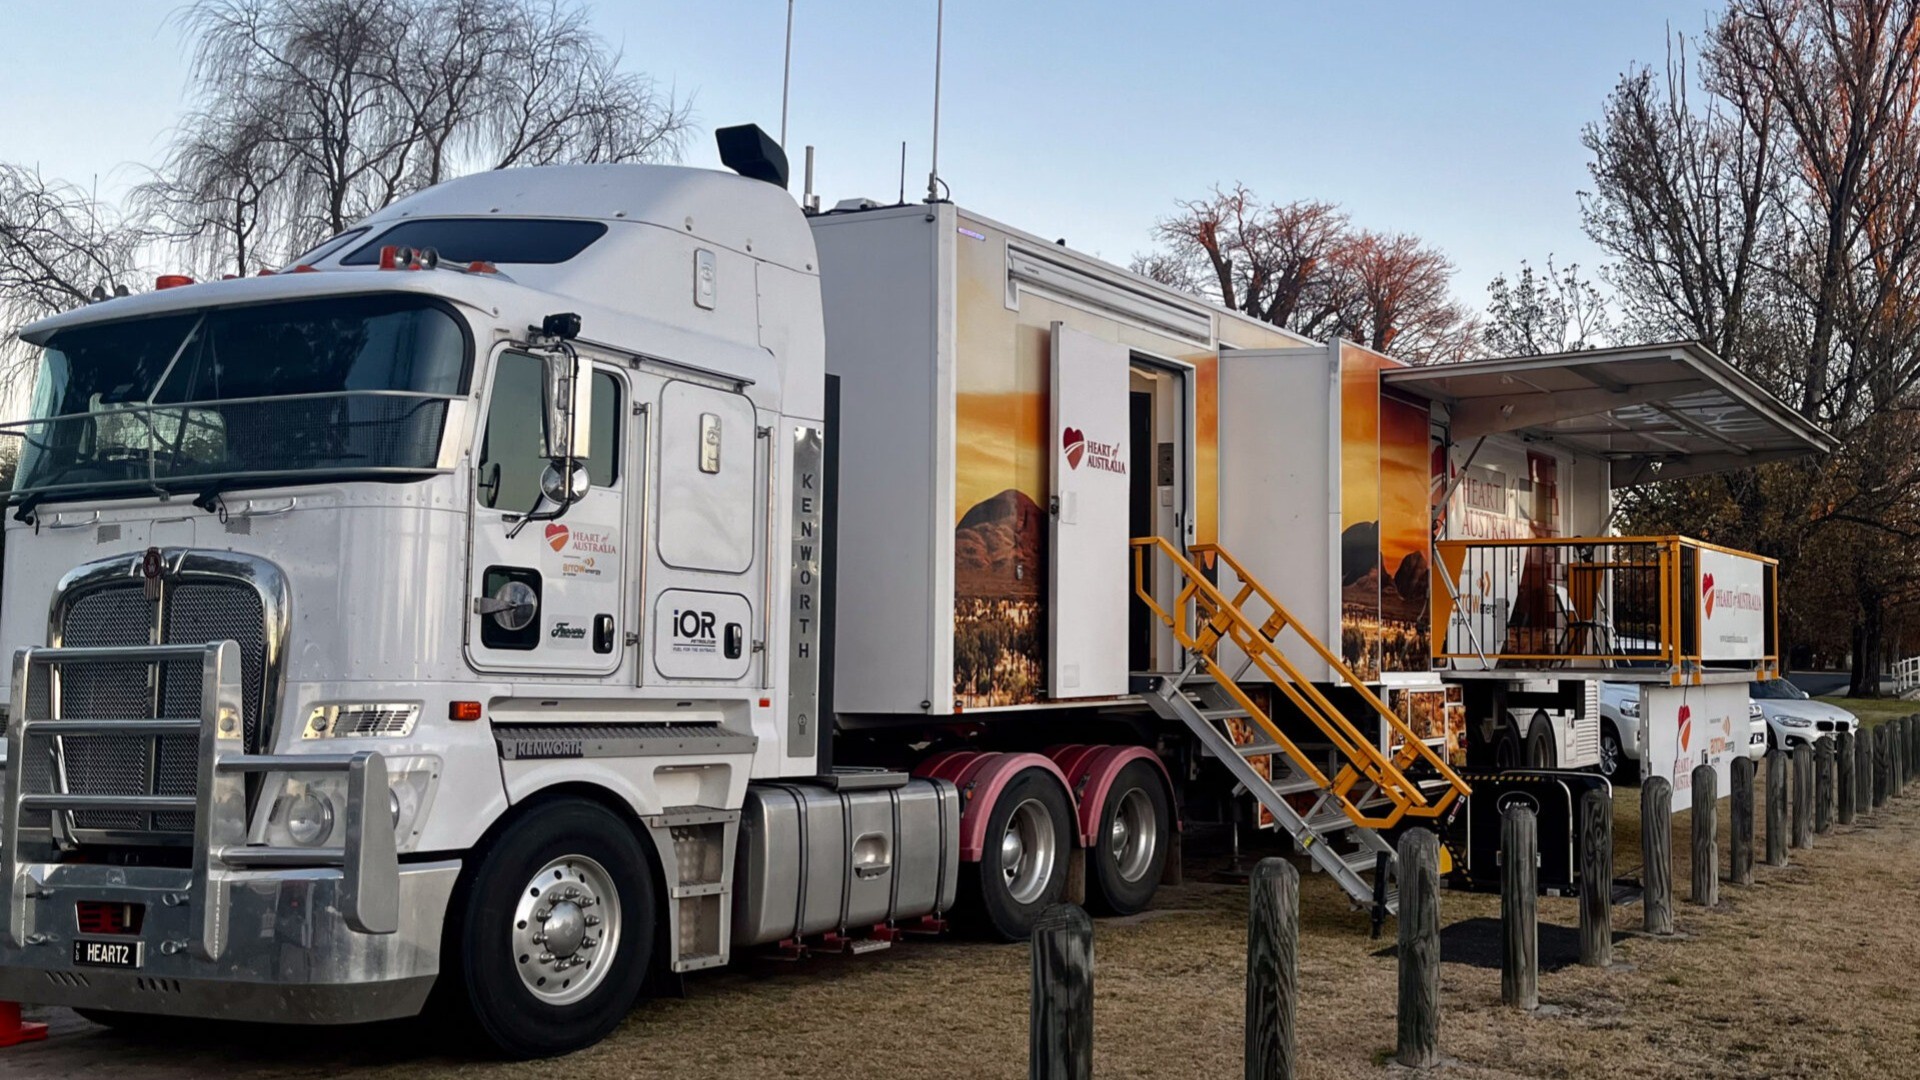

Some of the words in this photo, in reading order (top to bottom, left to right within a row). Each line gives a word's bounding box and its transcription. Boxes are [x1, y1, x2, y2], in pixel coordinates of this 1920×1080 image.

[1087, 440, 1111, 457] HEART
[1087, 455, 1126, 475] AUSTRALIA
[1462, 476, 1501, 509] HEART
[1461, 510, 1524, 541] AUSTRALIA
[573, 531, 600, 543] HEART
[573, 541, 617, 555] AUSTRALIA
[563, 563, 586, 574] arrow
[799, 473, 813, 658] KENWORTH
[1716, 589, 1733, 608] HEART
[1737, 591, 1762, 612] AUSTRALIA
[673, 609, 716, 639] iOR
[517, 739, 582, 756] KENWORTH
